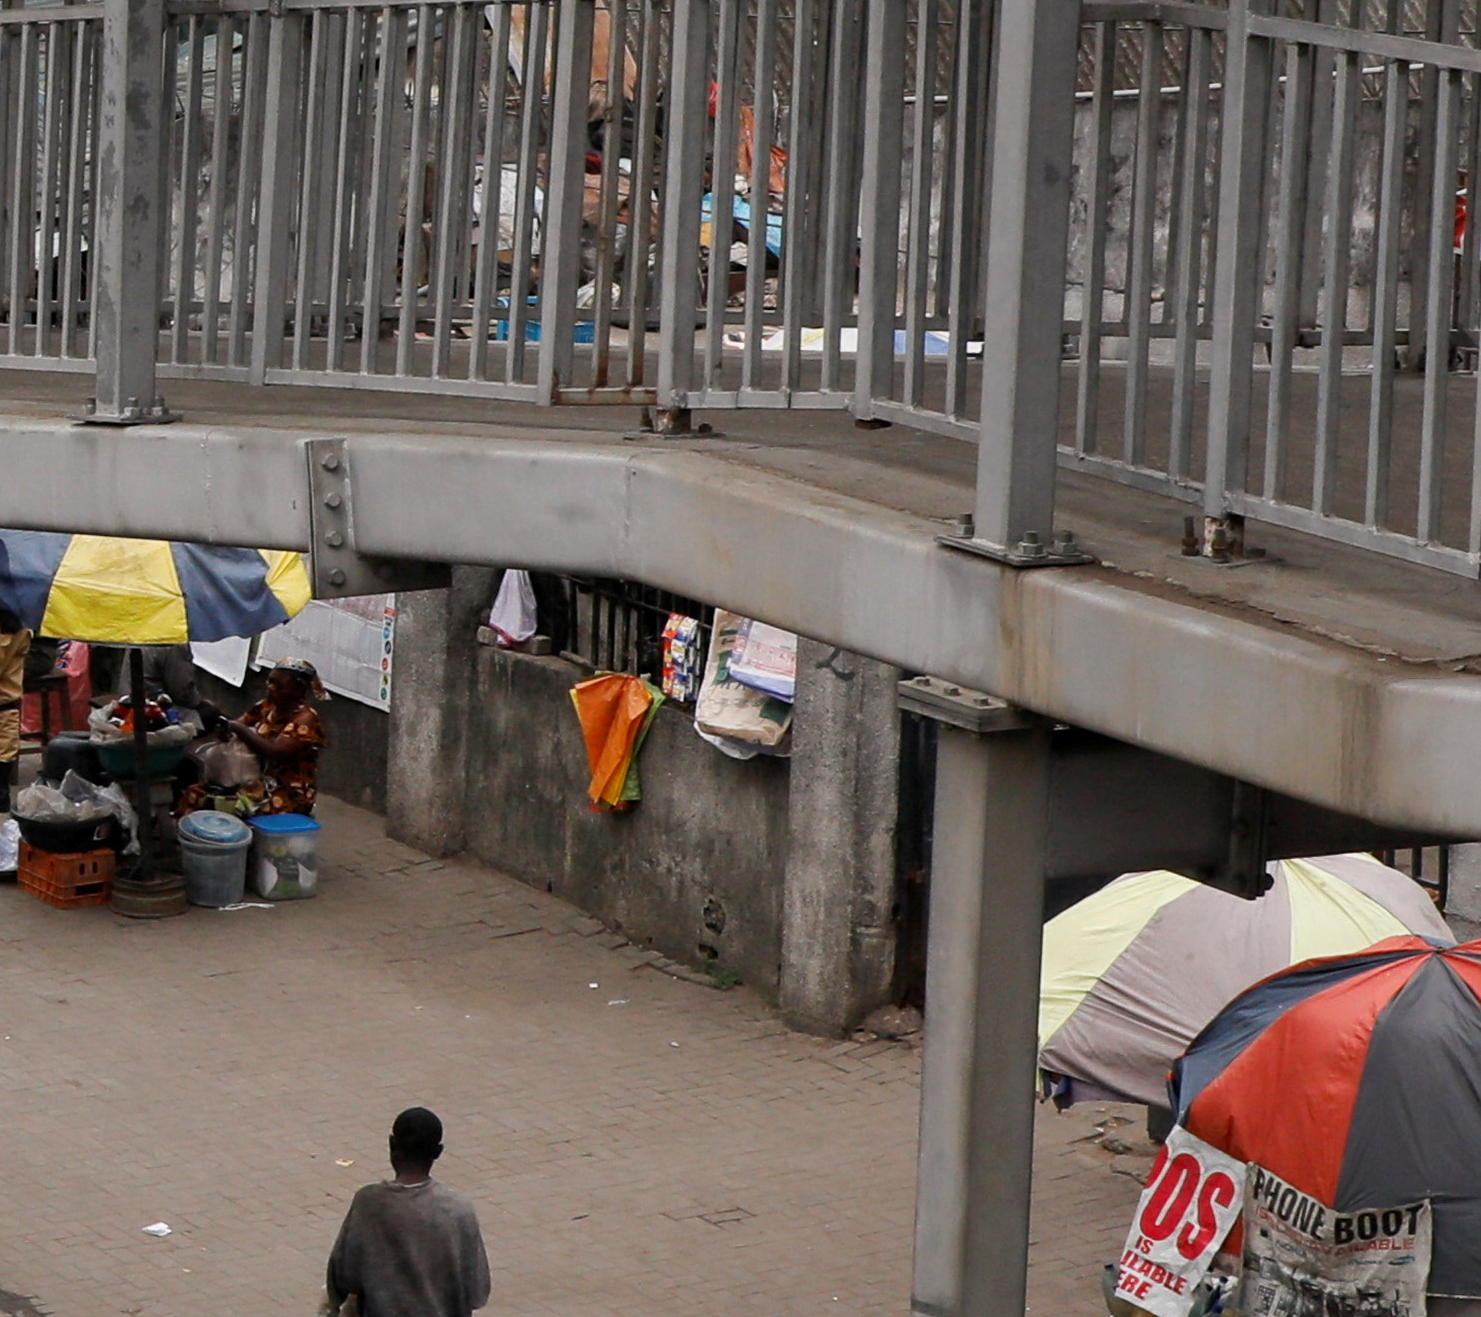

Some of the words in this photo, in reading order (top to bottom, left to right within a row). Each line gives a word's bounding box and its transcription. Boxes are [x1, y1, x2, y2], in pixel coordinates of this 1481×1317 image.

[1253, 1168, 1327, 1241] PHONE
[1334, 1203, 1425, 1245] BOOT
[1135, 1236, 1154, 1255] IS
